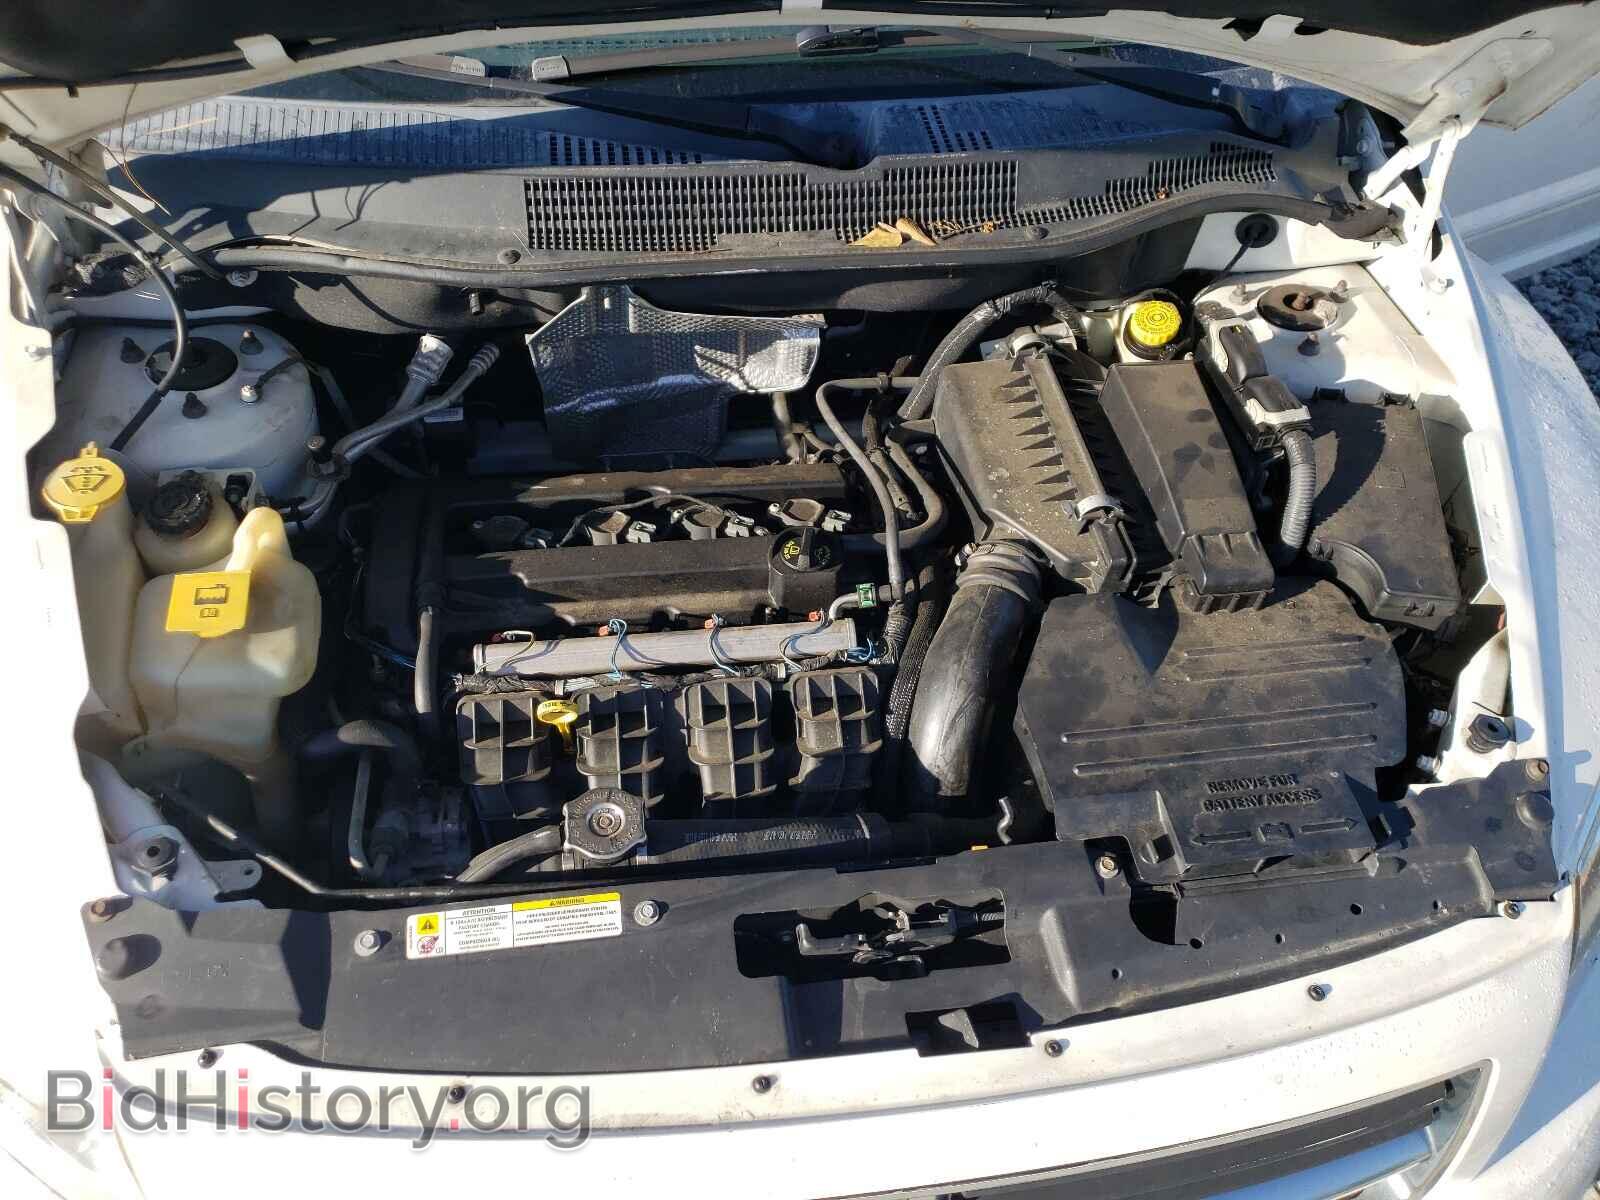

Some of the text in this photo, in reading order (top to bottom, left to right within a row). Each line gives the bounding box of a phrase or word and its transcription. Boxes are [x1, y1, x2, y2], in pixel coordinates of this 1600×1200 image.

[1207, 773, 1299, 794] REMOVE FOR
[1203, 788, 1322, 812] BATTERY ACCESS
[462, 906, 496, 916] ATTENTION
